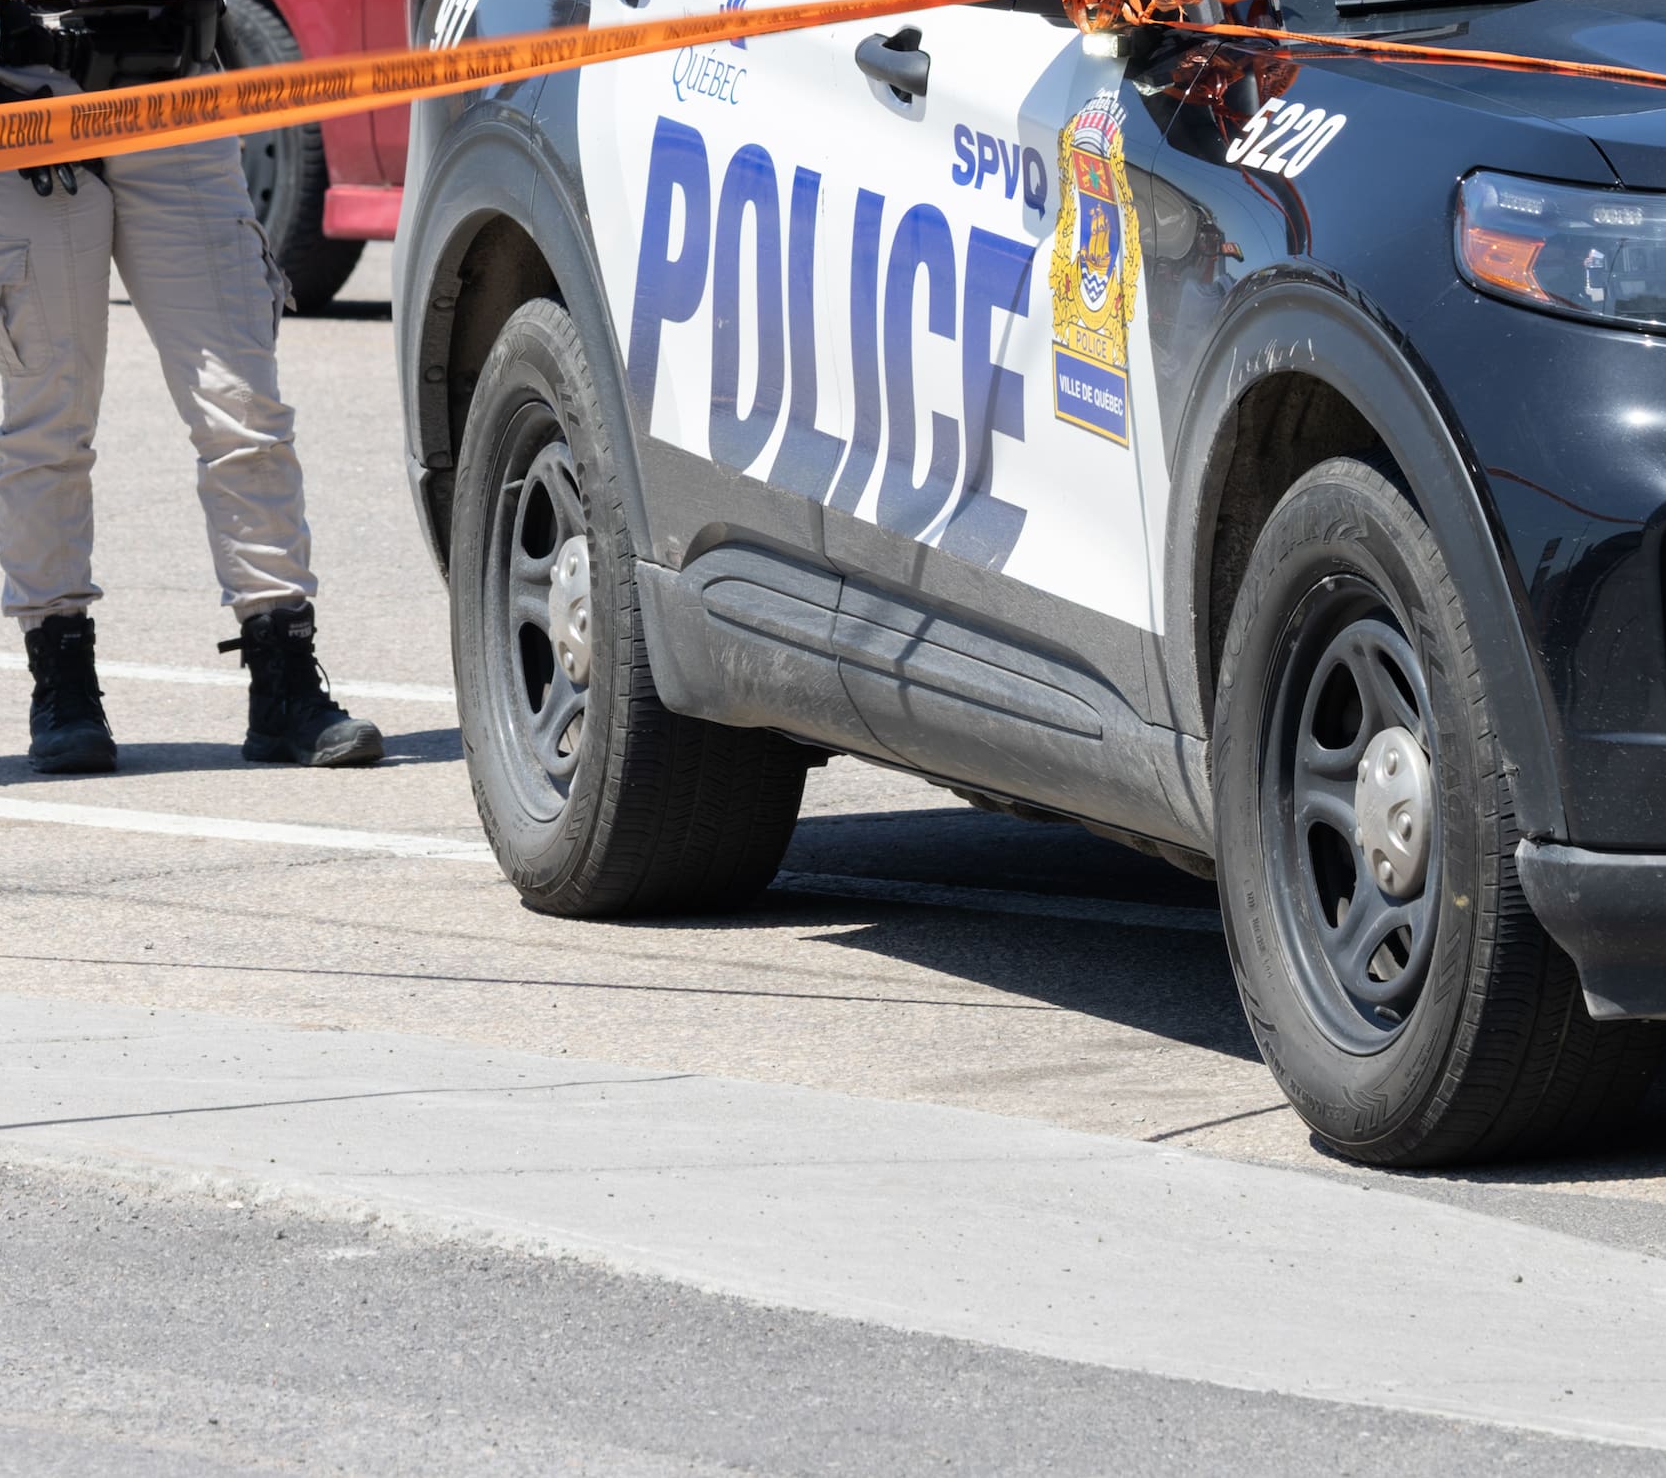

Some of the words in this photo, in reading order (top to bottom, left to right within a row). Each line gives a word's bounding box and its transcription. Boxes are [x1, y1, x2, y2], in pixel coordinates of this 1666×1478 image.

[673, 44, 747, 105] QUÉBEC
[952, 123, 1048, 220] SPVQ
[1225, 97, 1347, 178] 5220
[627, 116, 1039, 574] POLICE
[1075, 329, 1108, 360] POLICE
[1059, 373, 1081, 399] VILLE
[1081, 380, 1093, 404] DE
[1094, 386, 1123, 417] QUÉBEC
